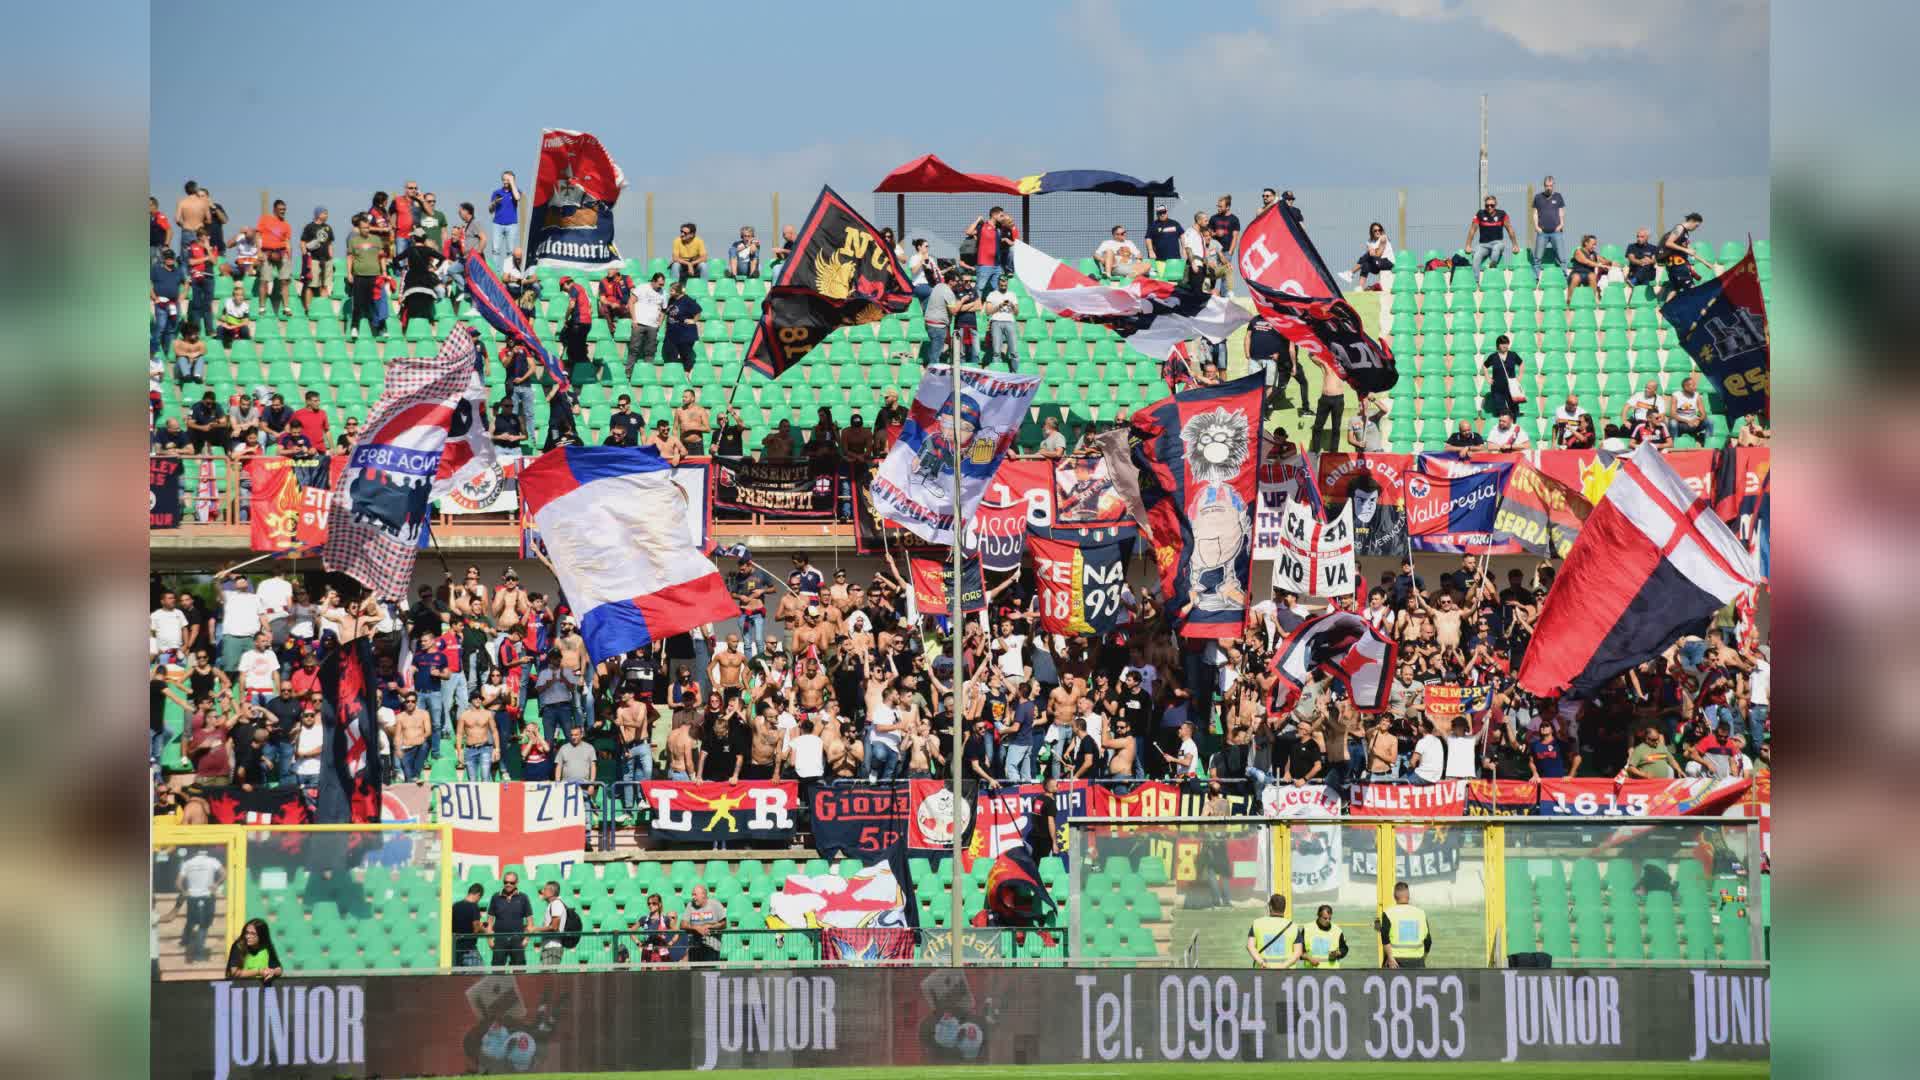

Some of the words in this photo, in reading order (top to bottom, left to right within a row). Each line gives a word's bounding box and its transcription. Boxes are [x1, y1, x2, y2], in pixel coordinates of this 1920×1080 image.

[736, 486, 813, 510] PRESENTI
[1406, 483, 1497, 525] Valleregia
[211, 981, 365, 1079] JUNIOR
[698, 972, 838, 1070] JUNIOR
[1075, 974, 1144, 1060] Tel.
[1159, 974, 1267, 1060] 0984
[1280, 974, 1349, 1060] 186
[1363, 974, 1466, 1060] 3853
[1501, 969, 1621, 1062] JUNIOR
